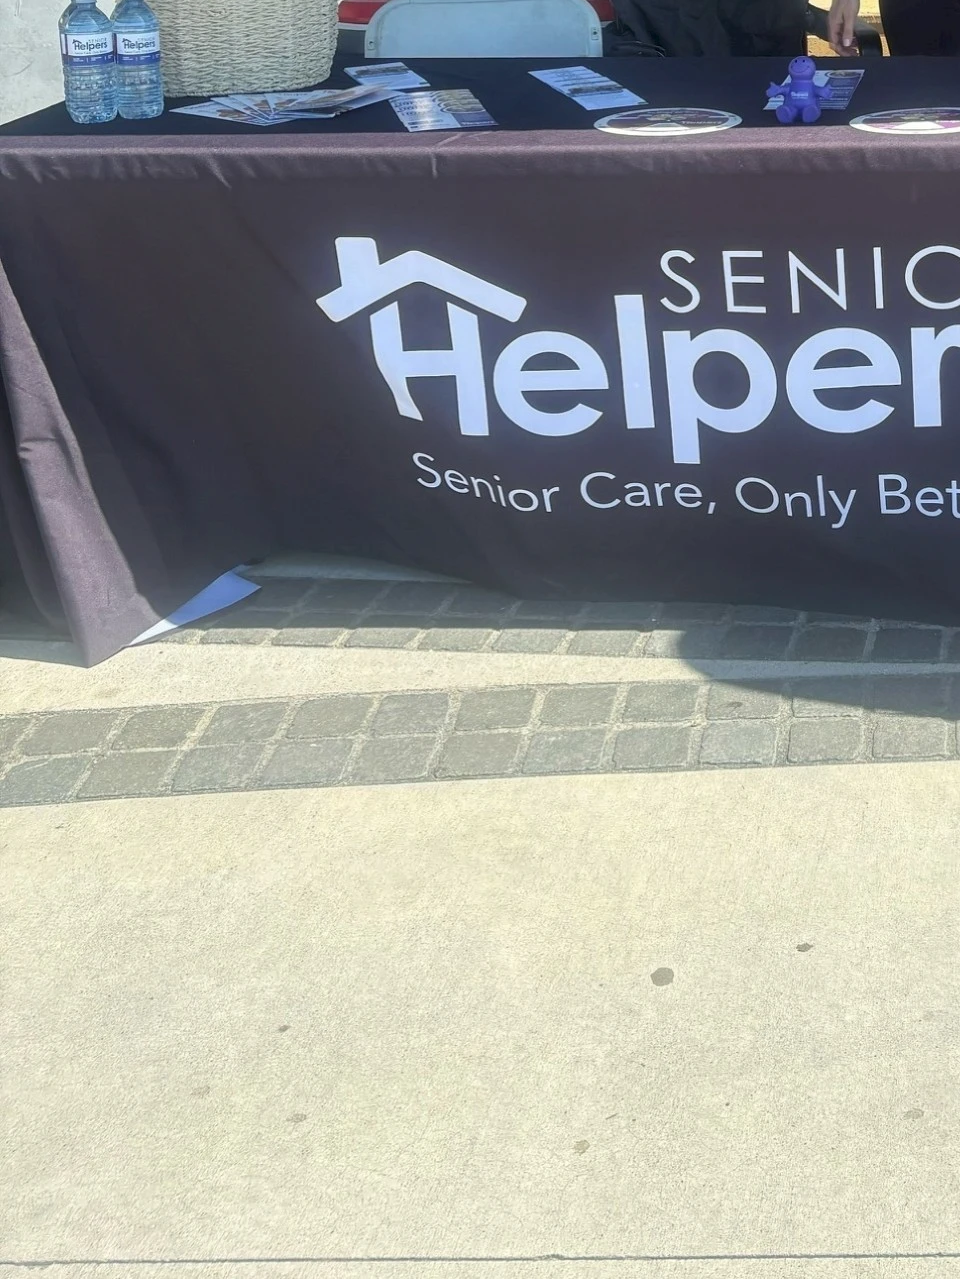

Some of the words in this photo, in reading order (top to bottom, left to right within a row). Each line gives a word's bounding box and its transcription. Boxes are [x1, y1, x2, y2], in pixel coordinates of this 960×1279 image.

[74, 40, 108, 51] Helpers
[124, 40, 156, 51] Helpers
[412, 452, 560, 513] Senior
[579, 471, 716, 514] Care,
[735, 475, 857, 529] Only
